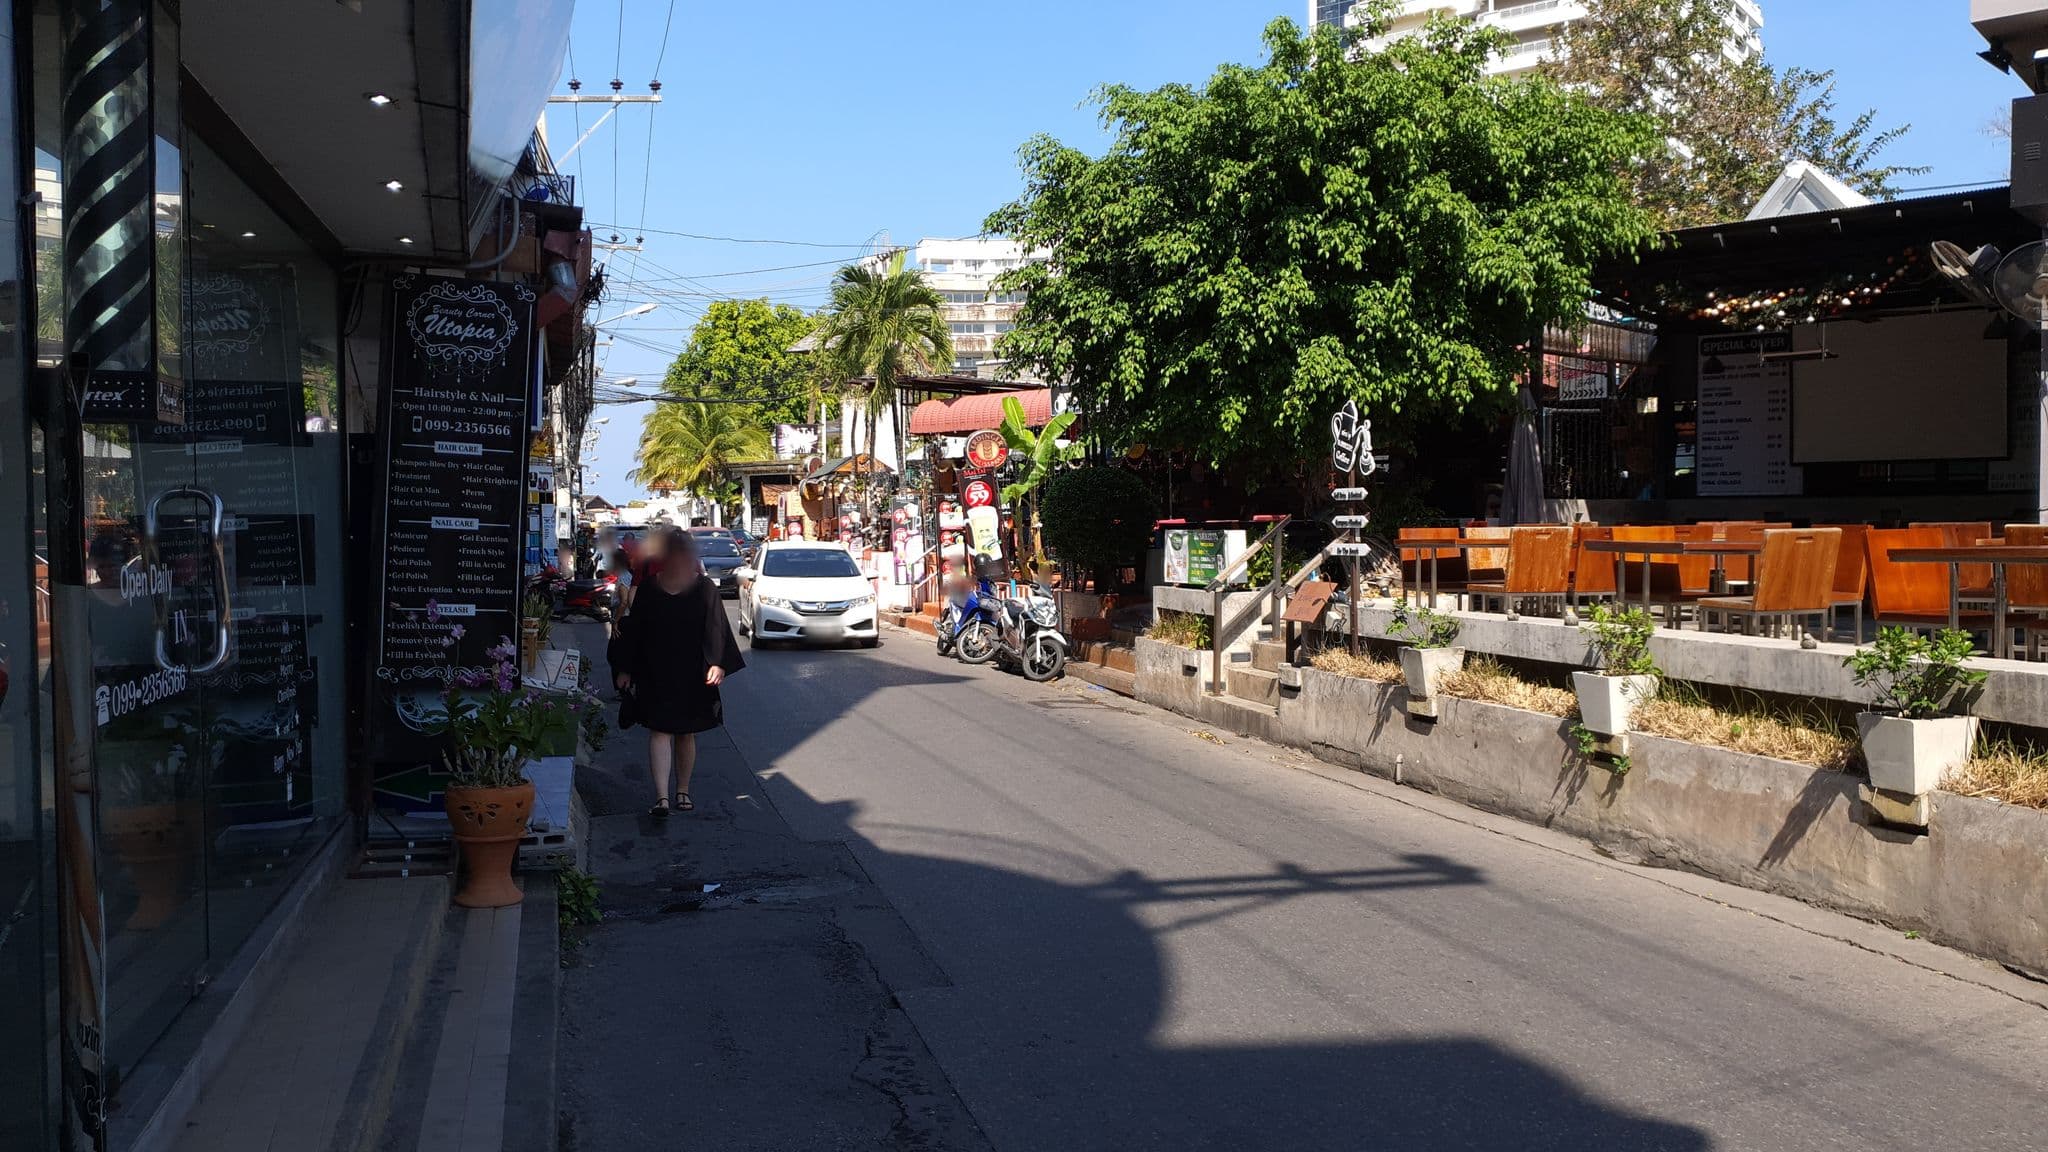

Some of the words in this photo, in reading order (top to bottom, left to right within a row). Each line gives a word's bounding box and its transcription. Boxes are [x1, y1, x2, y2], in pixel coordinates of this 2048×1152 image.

[432, 304, 463, 318] Beauty
[466, 307, 496, 319] Corner
[423, 314, 497, 342] Utopia
[414, 387, 467, 402] Hairstyle
[469, 391, 479, 401] &
[481, 391, 504, 403] Nail
[402, 403, 425, 413] Open
[427, 403, 451, 413] 10:00
[472, 407, 497, 416] 22:00
[424, 419, 511, 436] 099-2356566
[970, 433, 1003, 449] ERDINGER
[467, 462, 484, 470] Hair
[467, 476, 483, 484] Hair
[465, 489, 485, 497] Perm
[969, 489, 990, 506] 59
[464, 501, 492, 511] Waxing
[434, 519, 453, 528] NAIL
[393, 532, 429, 540] Manicure
[461, 548, 486, 556] French
[120, 565, 148, 606] Open
[150, 563, 173, 600] Daily
[421, 623, 457, 631] Extensio
